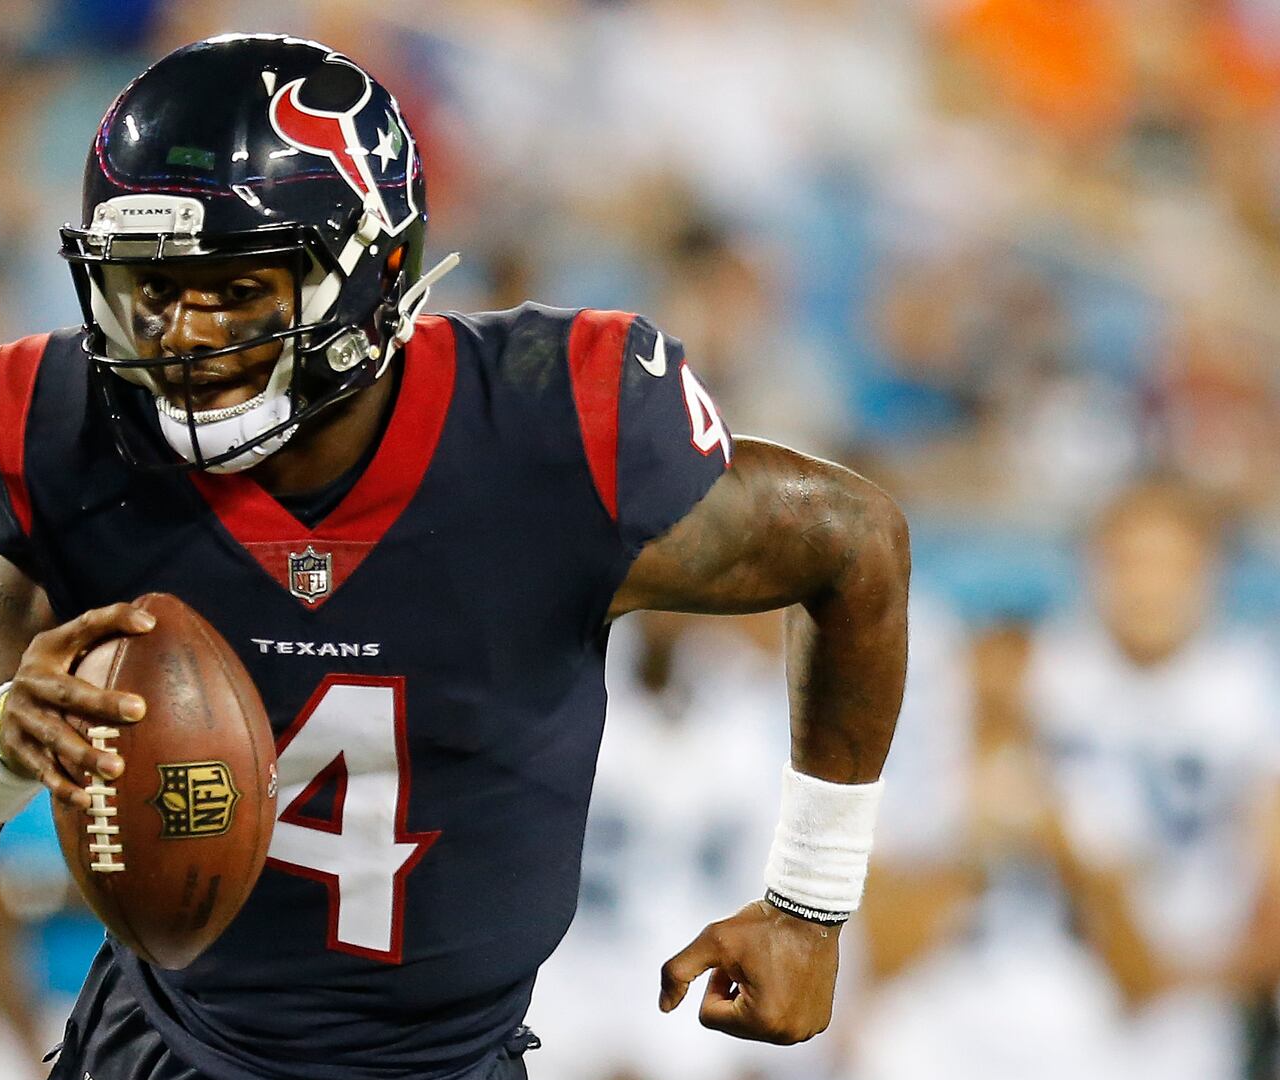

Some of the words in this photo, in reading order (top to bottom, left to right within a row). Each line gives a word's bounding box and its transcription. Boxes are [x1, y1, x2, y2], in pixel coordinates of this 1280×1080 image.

[121, 208, 172, 216] TEXANS
[679, 358, 733, 469] 4
[250, 638, 381, 657] TEXANS
[192, 769, 229, 829] NFL
[267, 672, 443, 965] 4
